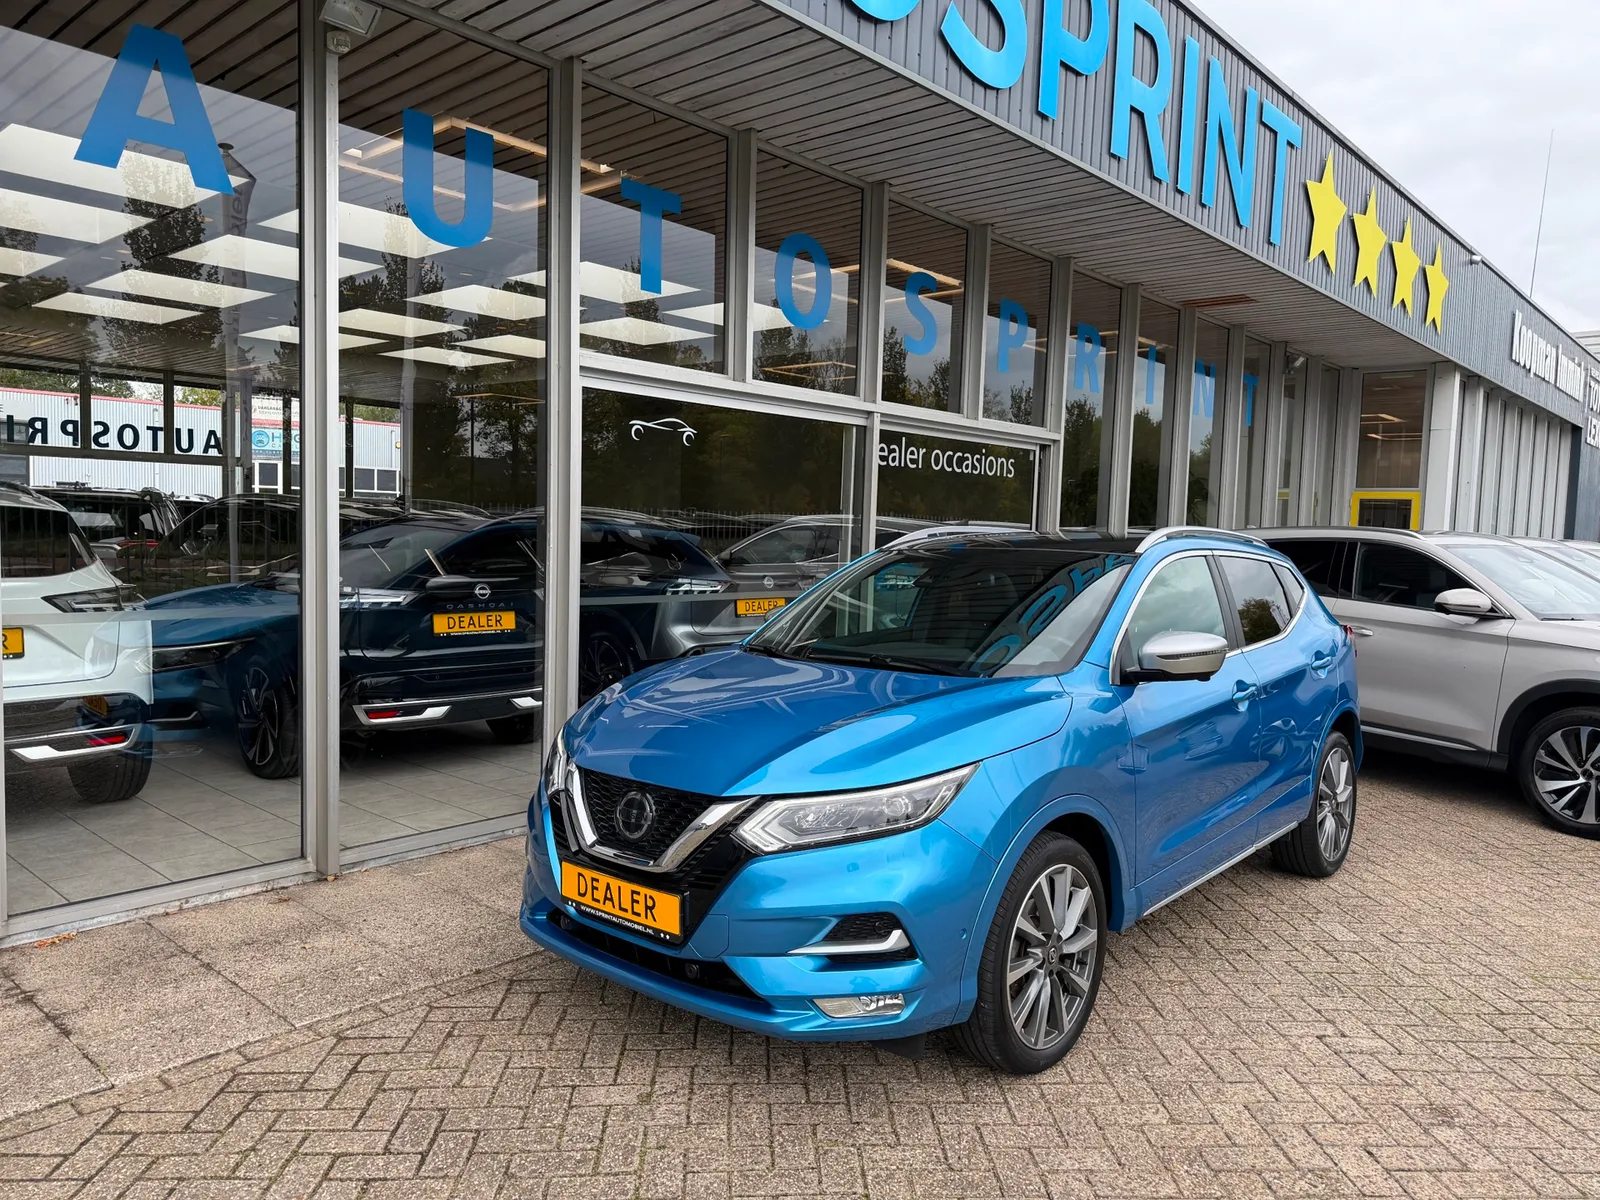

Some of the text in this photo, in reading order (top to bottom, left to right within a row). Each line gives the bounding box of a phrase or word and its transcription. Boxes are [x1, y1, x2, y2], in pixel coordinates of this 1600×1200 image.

[1512, 309, 1556, 385] Koopman
[931, 449, 1016, 479] occasions
[447, 614, 503, 629] DEALER
[577, 872, 657, 922] DEALER
